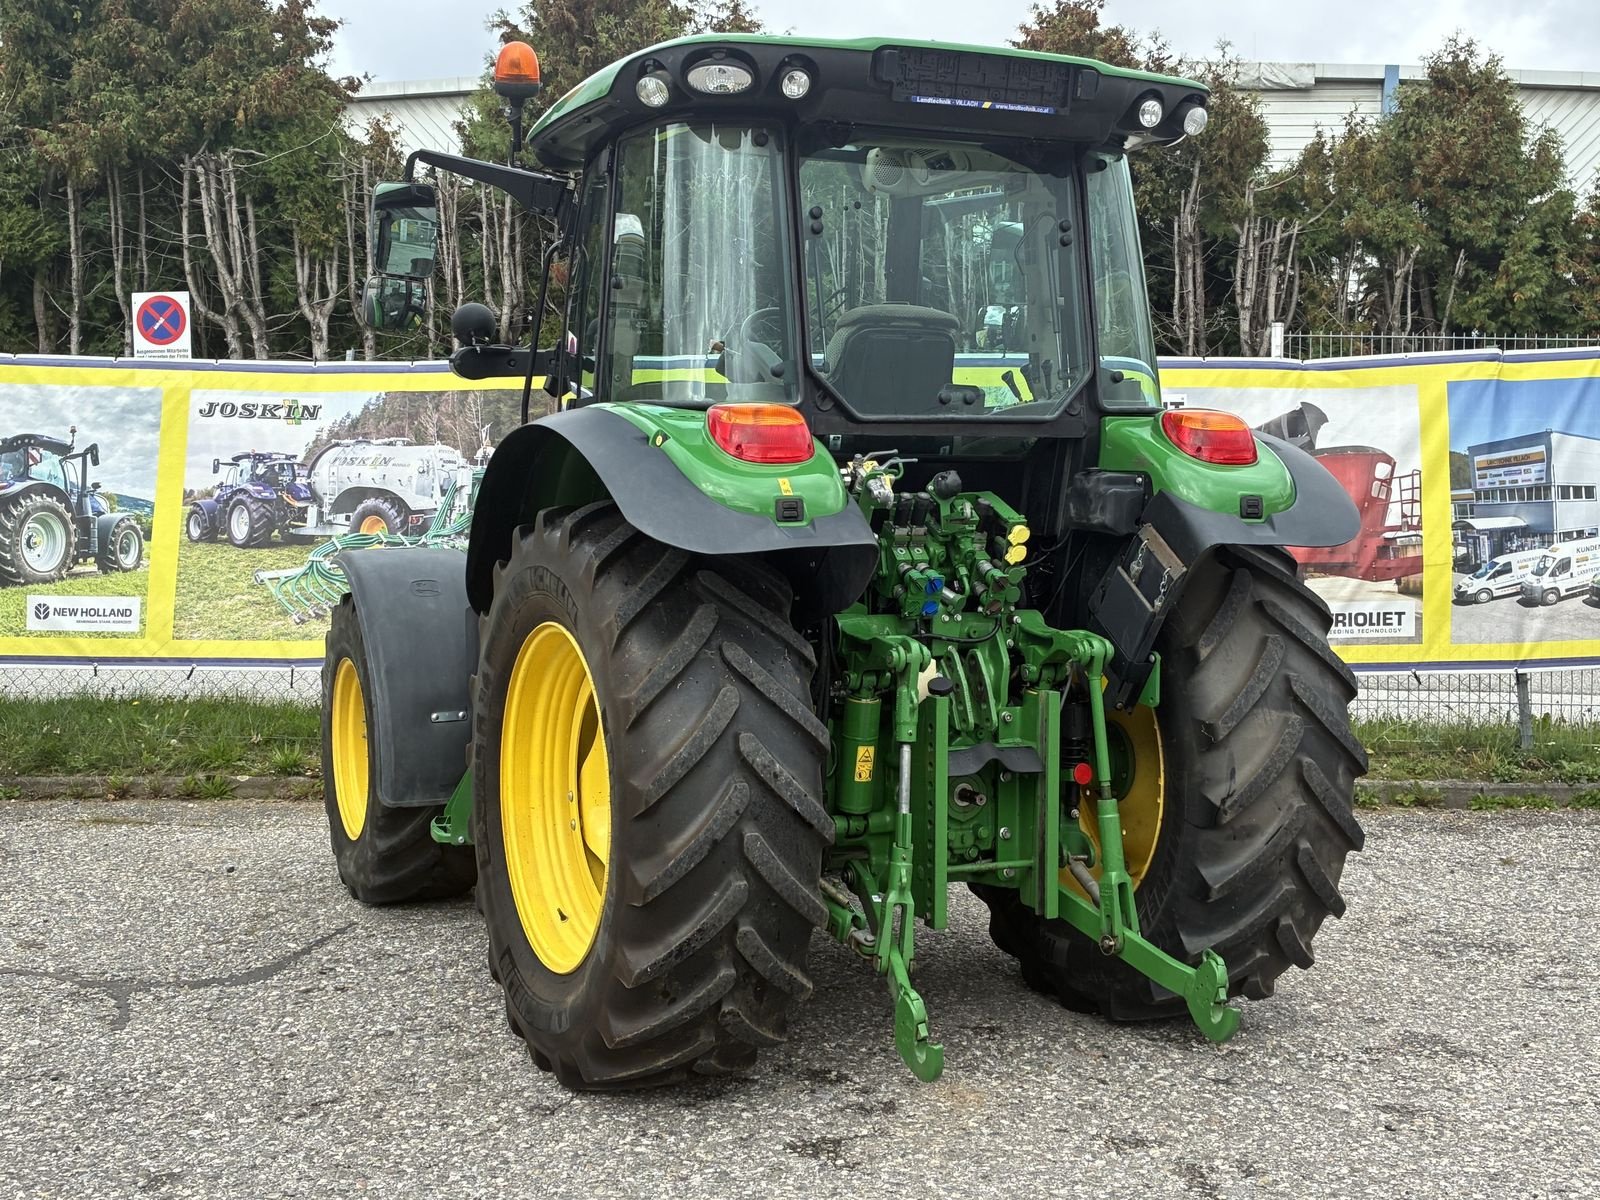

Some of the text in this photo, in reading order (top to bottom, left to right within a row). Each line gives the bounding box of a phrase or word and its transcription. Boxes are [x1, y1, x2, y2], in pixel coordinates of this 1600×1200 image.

[916, 96, 951, 105] Landtechnik
[956, 99, 978, 107] VILLACH
[198, 401, 322, 421] JOSKIN
[53, 607, 133, 618] NEW HOLLAND
